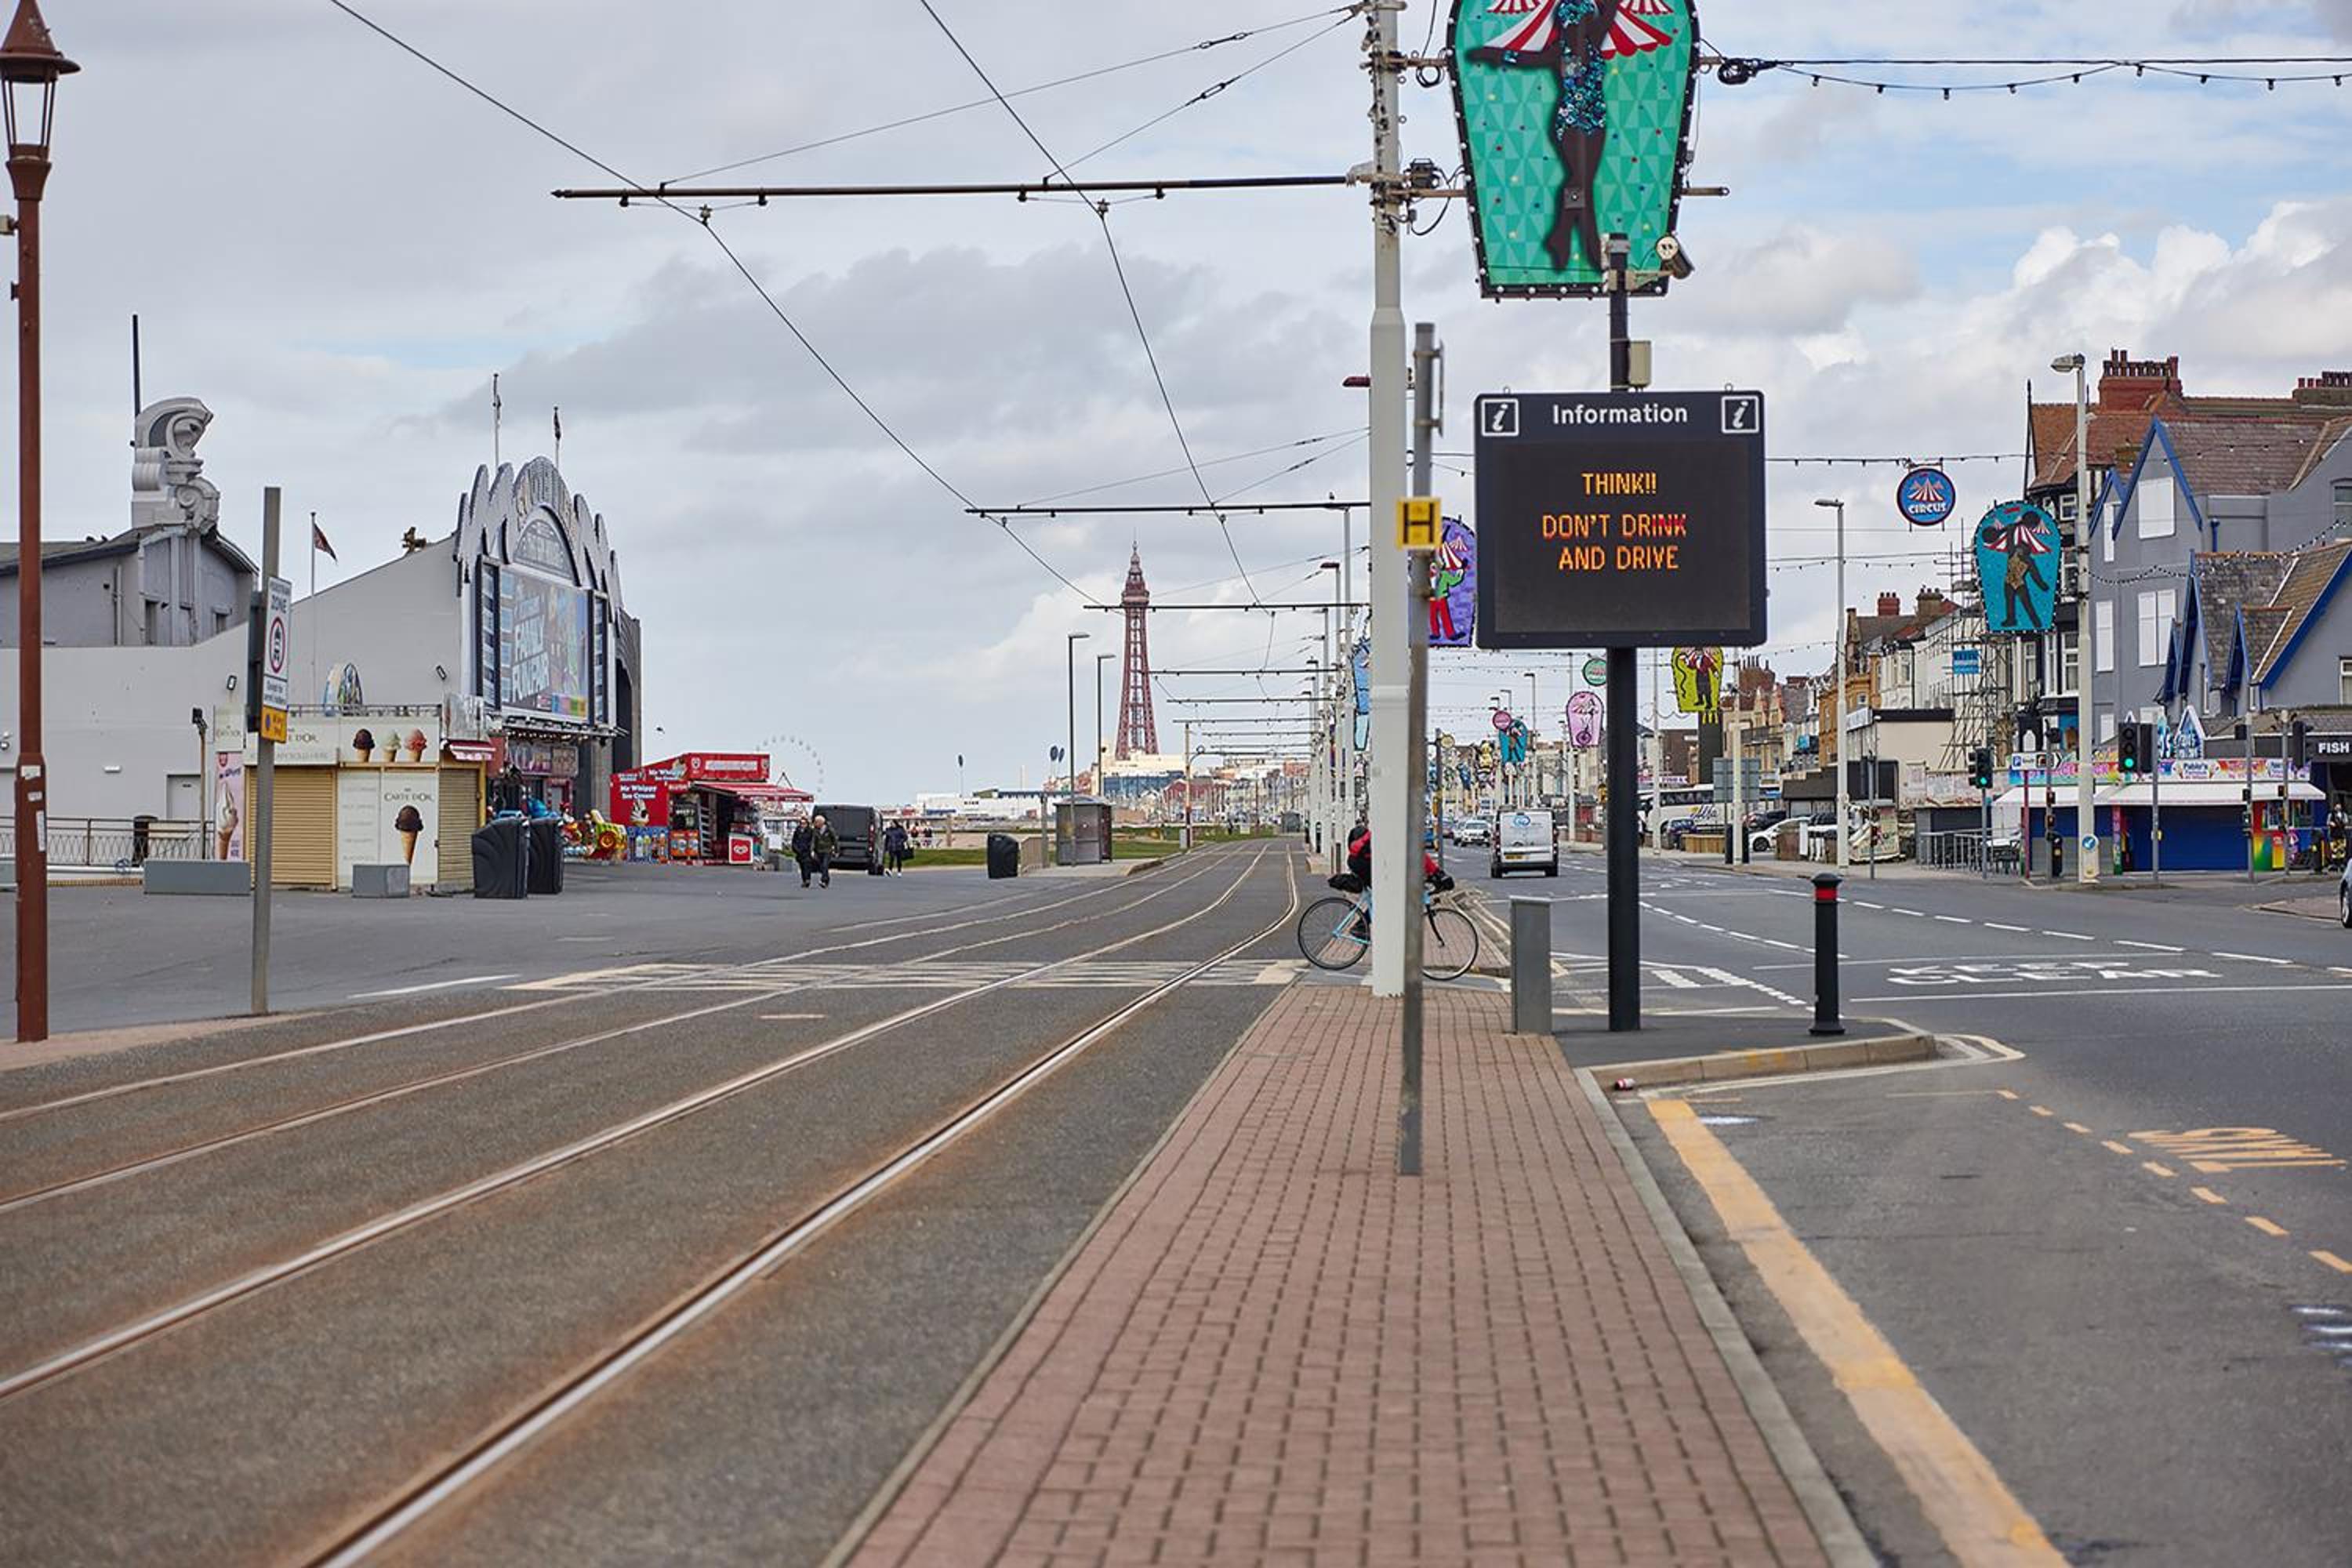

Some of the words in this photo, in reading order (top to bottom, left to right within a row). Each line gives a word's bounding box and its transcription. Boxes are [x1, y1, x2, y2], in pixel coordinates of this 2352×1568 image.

[1553, 403, 1688, 424] Information
[1581, 472, 1657, 495] THINK!!
[1909, 502, 1947, 514] CIRCUS
[1403, 503, 1434, 544] H
[1541, 513, 1611, 539] DON'T
[1621, 513, 1687, 538] DRINK
[1559, 546, 1606, 571] AND
[1616, 546, 1679, 570] DRIVE
[2318, 742, 2350, 753] FISH
